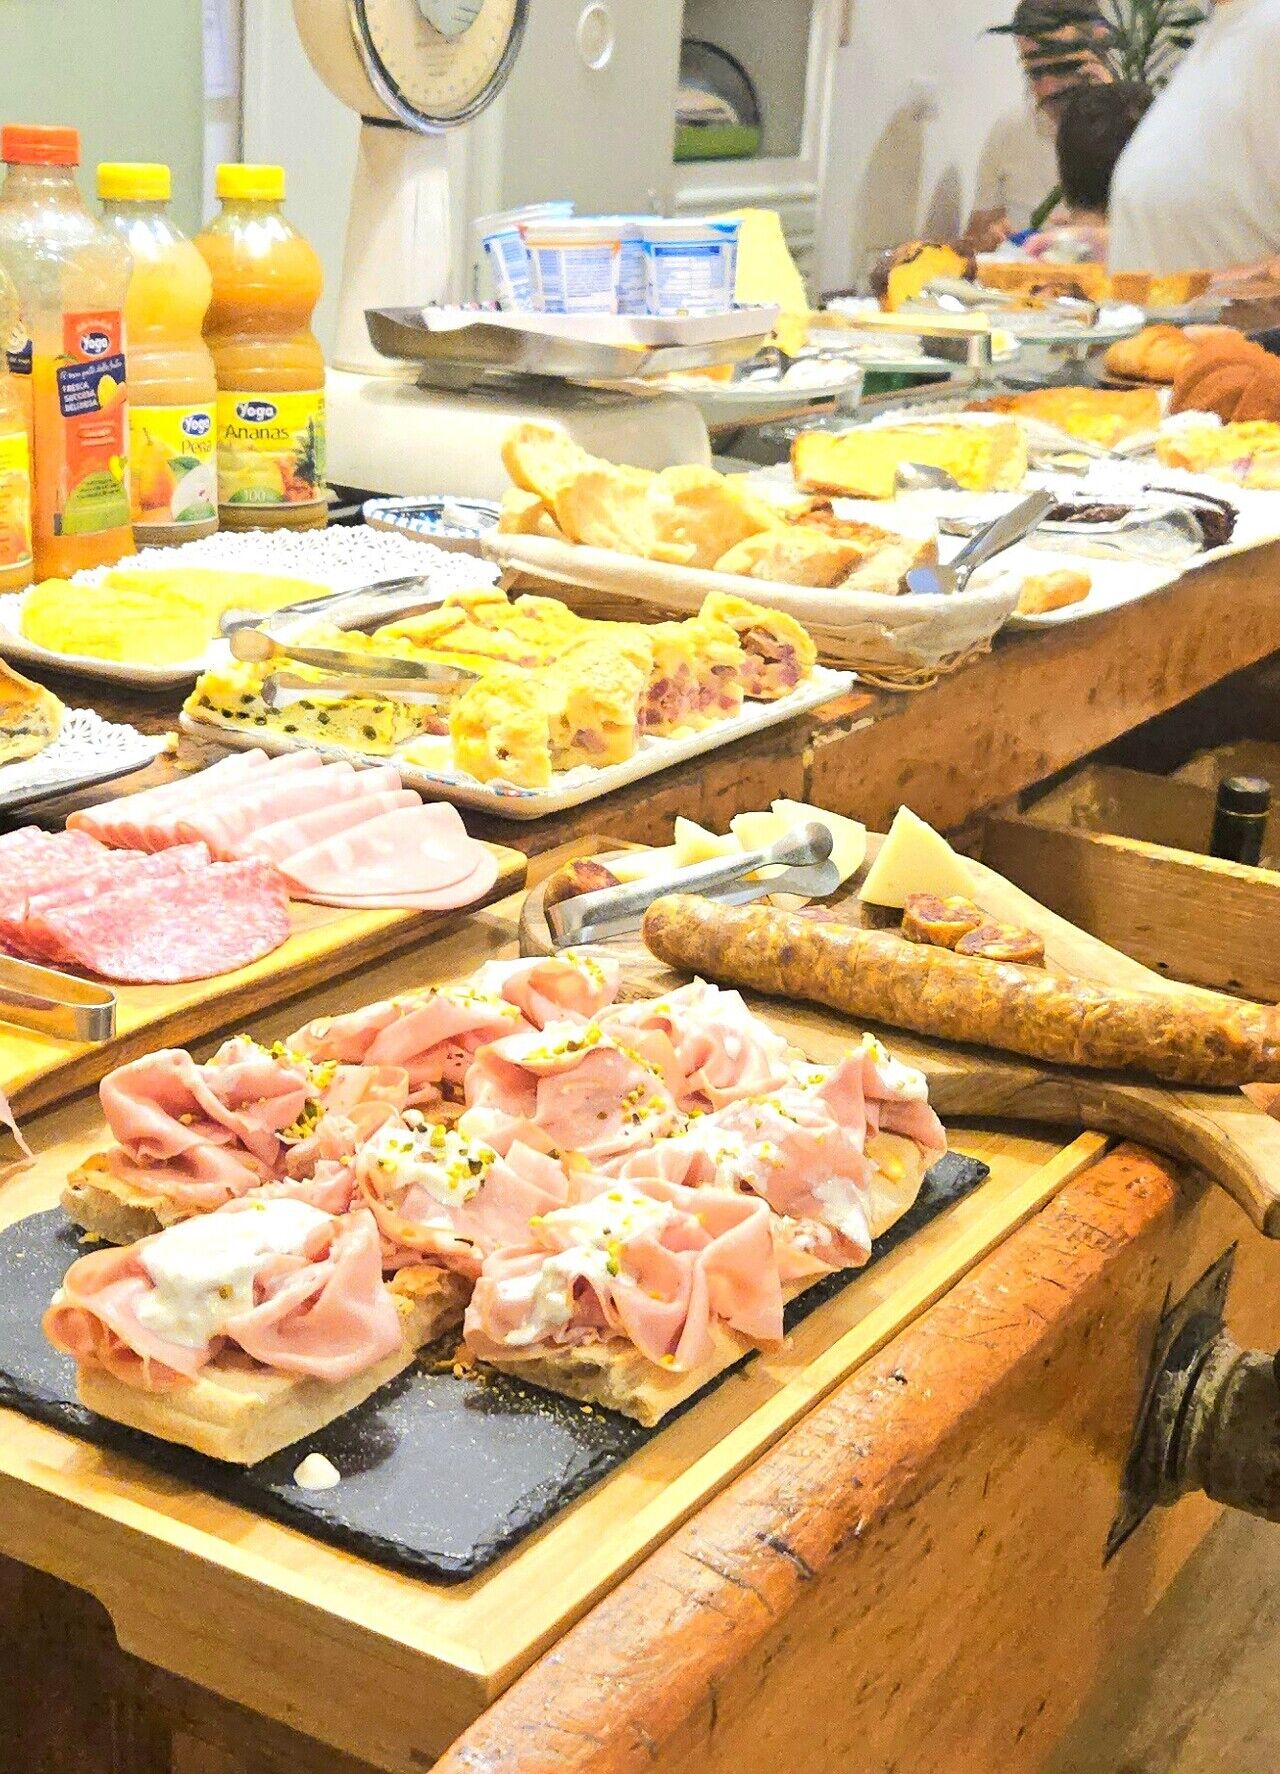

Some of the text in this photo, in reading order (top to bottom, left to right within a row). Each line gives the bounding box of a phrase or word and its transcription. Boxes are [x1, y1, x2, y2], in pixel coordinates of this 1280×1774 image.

[81, 334, 108, 353] Yoga
[238, 402, 274, 421] Yoga
[184, 417, 210, 434] Yoga
[225, 424, 290, 440] Ananas
